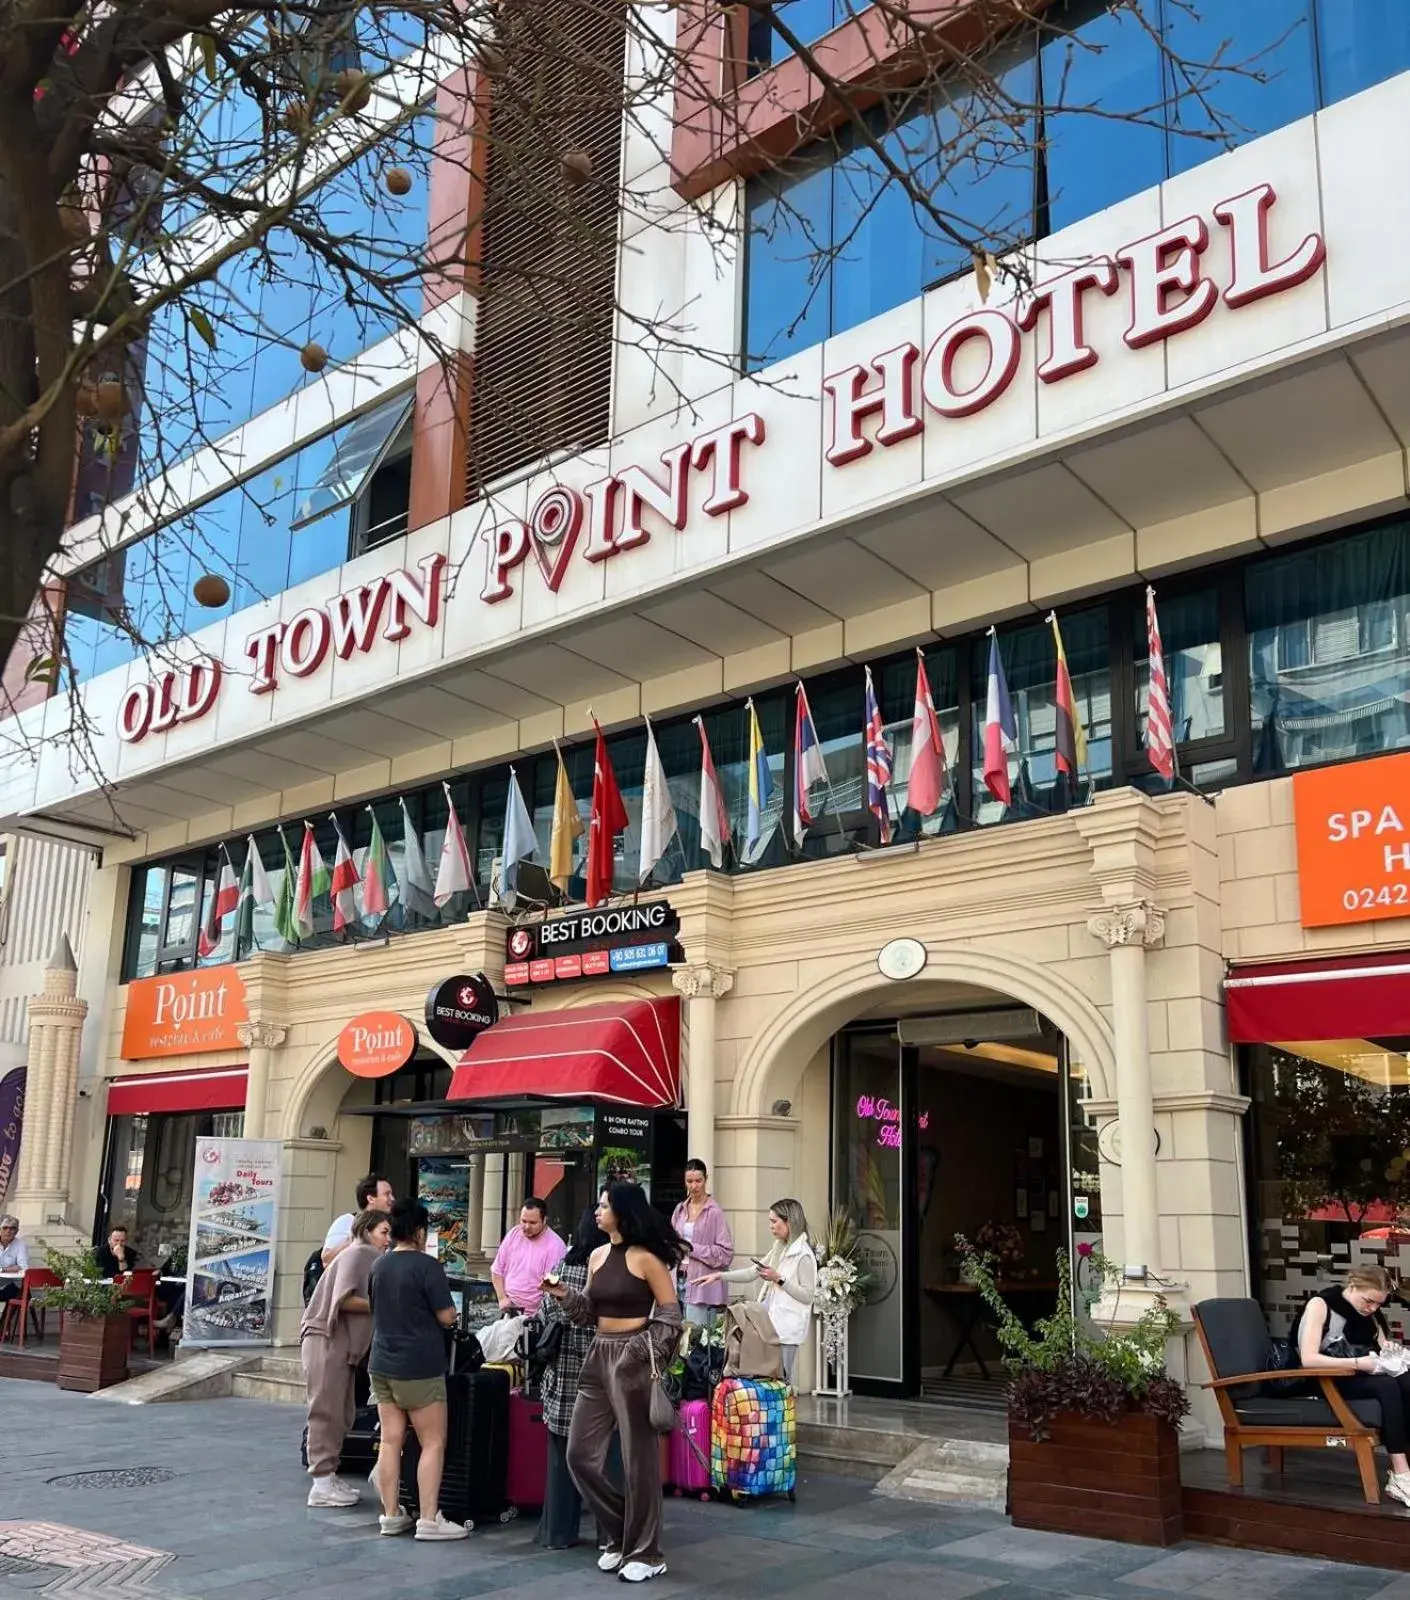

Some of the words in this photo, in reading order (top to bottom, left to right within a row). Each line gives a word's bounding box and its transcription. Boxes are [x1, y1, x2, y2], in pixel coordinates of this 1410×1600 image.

[116, 654, 222, 743] OLD
[246, 552, 447, 695] TOWN
[480, 412, 766, 605] POINT
[822, 182, 1326, 467] HOTEL
[1327, 805, 1405, 842] SPA
[1343, 884, 1408, 910] 0242
[541, 919, 579, 944] BEST
[581, 905, 666, 938] BOOKING
[152, 977, 227, 1030] Point
[436, 1006, 455, 1017] BEST
[455, 1009, 491, 1024] BOOKING
[351, 1023, 404, 1055] Point
[856, 1094, 875, 1119] Old
[615, 1116, 627, 1125] ONE
[630, 1128, 643, 1137] TOUR
[236, 1170, 257, 1180] Daily
[251, 1178, 274, 1186] Tours
[233, 1219, 252, 1230] Tour
